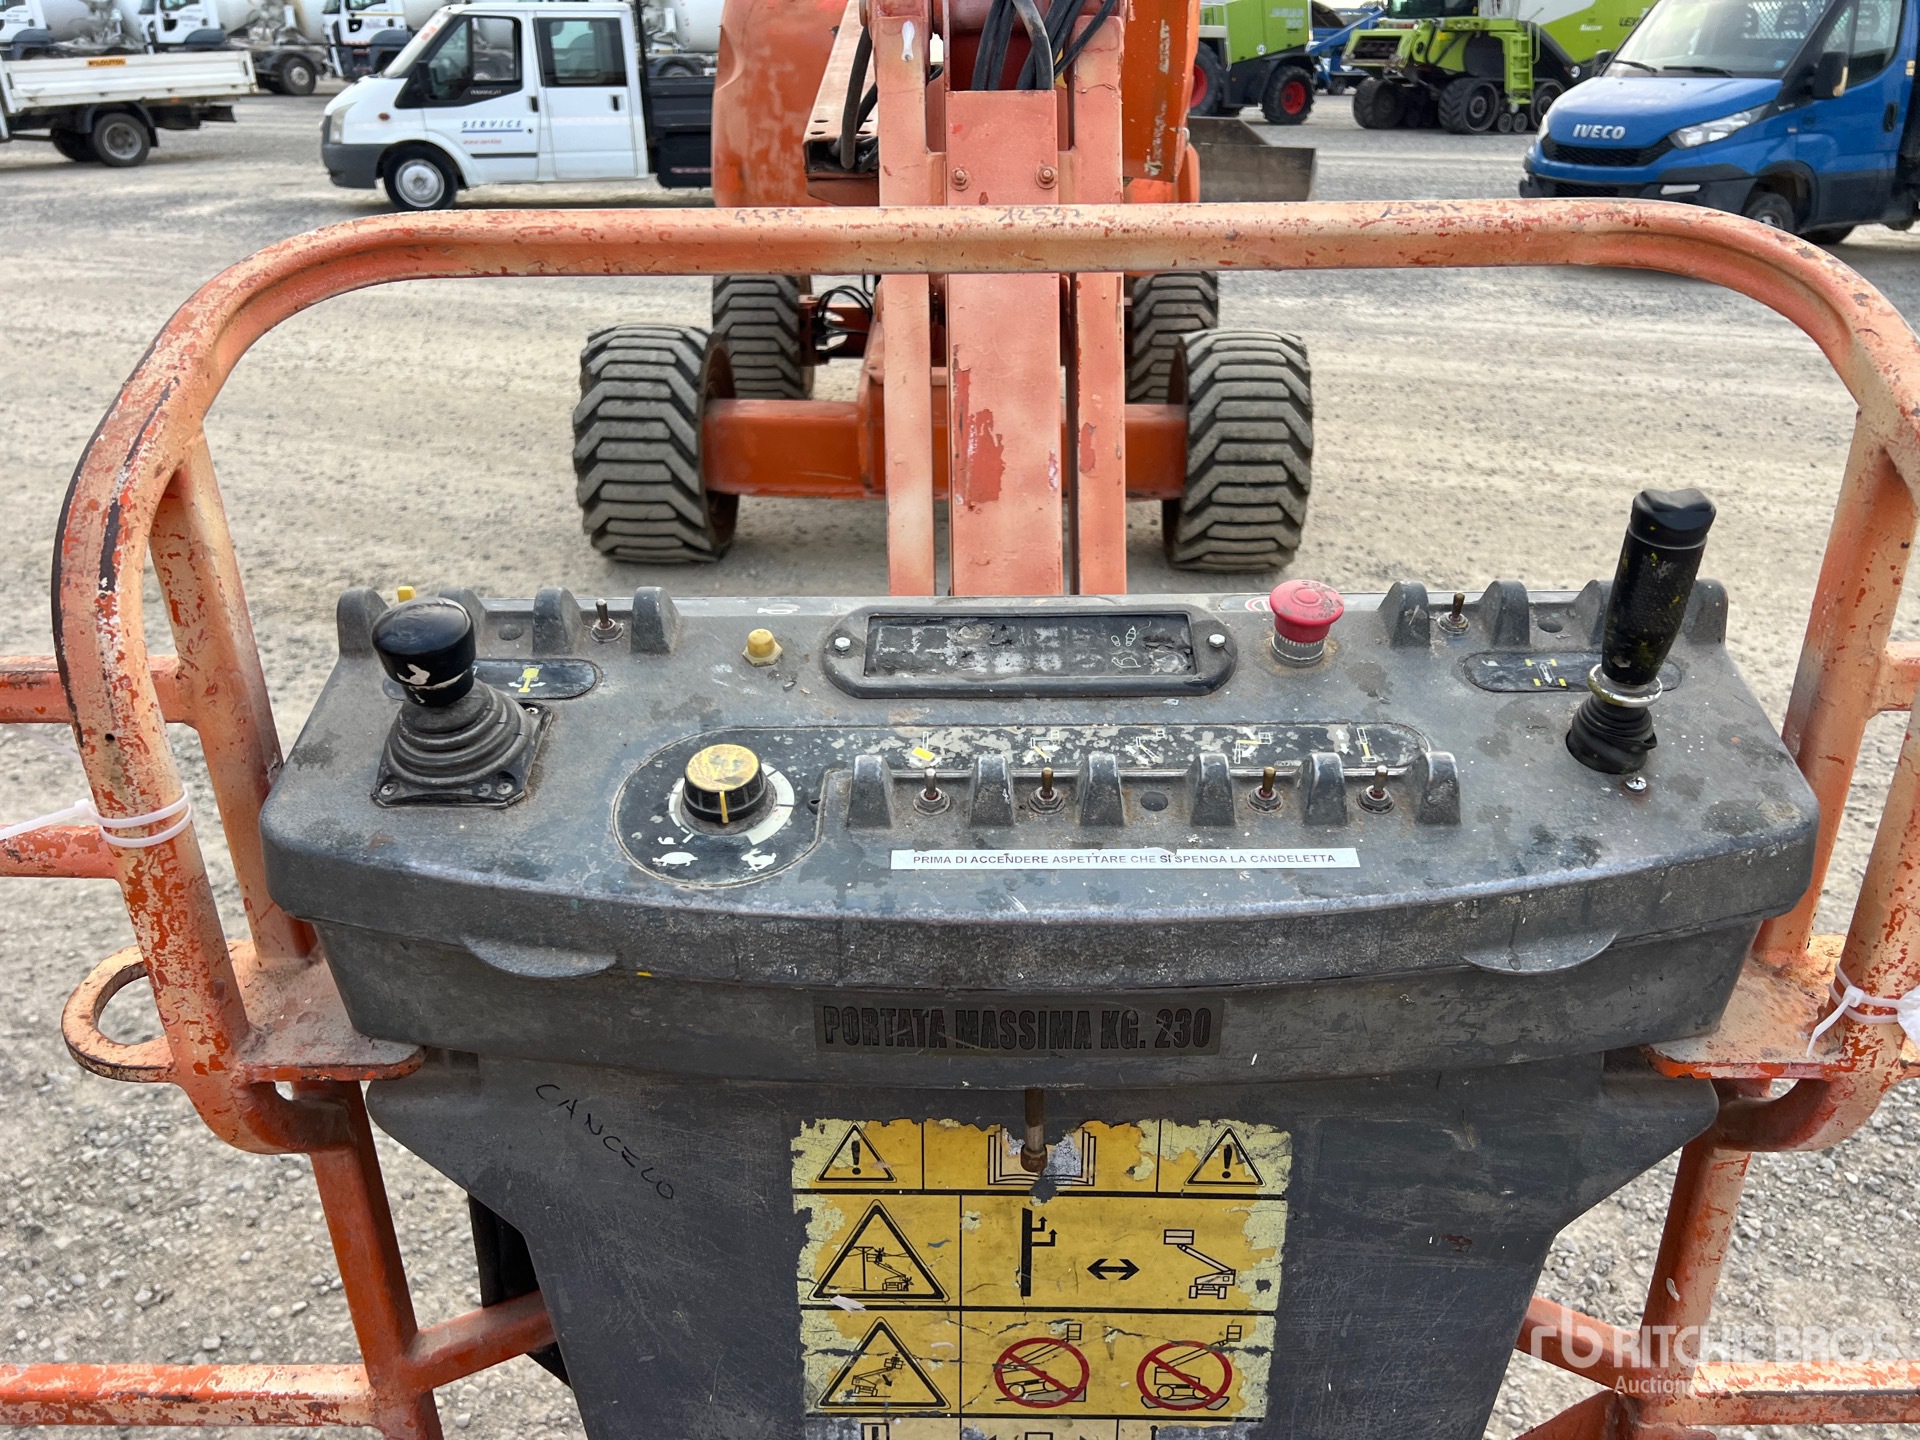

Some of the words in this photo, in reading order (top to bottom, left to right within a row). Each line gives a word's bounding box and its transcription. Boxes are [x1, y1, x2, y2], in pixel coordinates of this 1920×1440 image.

[461, 120, 523, 129] SERVICE
[1572, 123, 1626, 140] IVECO
[913, 855, 952, 864] PRIMA
[955, 855, 968, 864] DI
[970, 855, 1049, 864] ACCENDERE
[1052, 855, 1128, 864] ASPETTARE
[1130, 855, 1156, 864] CHE
[1159, 854, 1171, 864] SI
[1174, 854, 1228, 864] SPENGA
[1230, 854, 1247, 864] LA
[1250, 854, 1336, 864] CANDELETTA
[823, 1006, 947, 1048] PORTATA
[955, 1010, 1092, 1050] MASSIMA
[1101, 1010, 1147, 1049] KG.
[1155, 1007, 1212, 1048] 230
